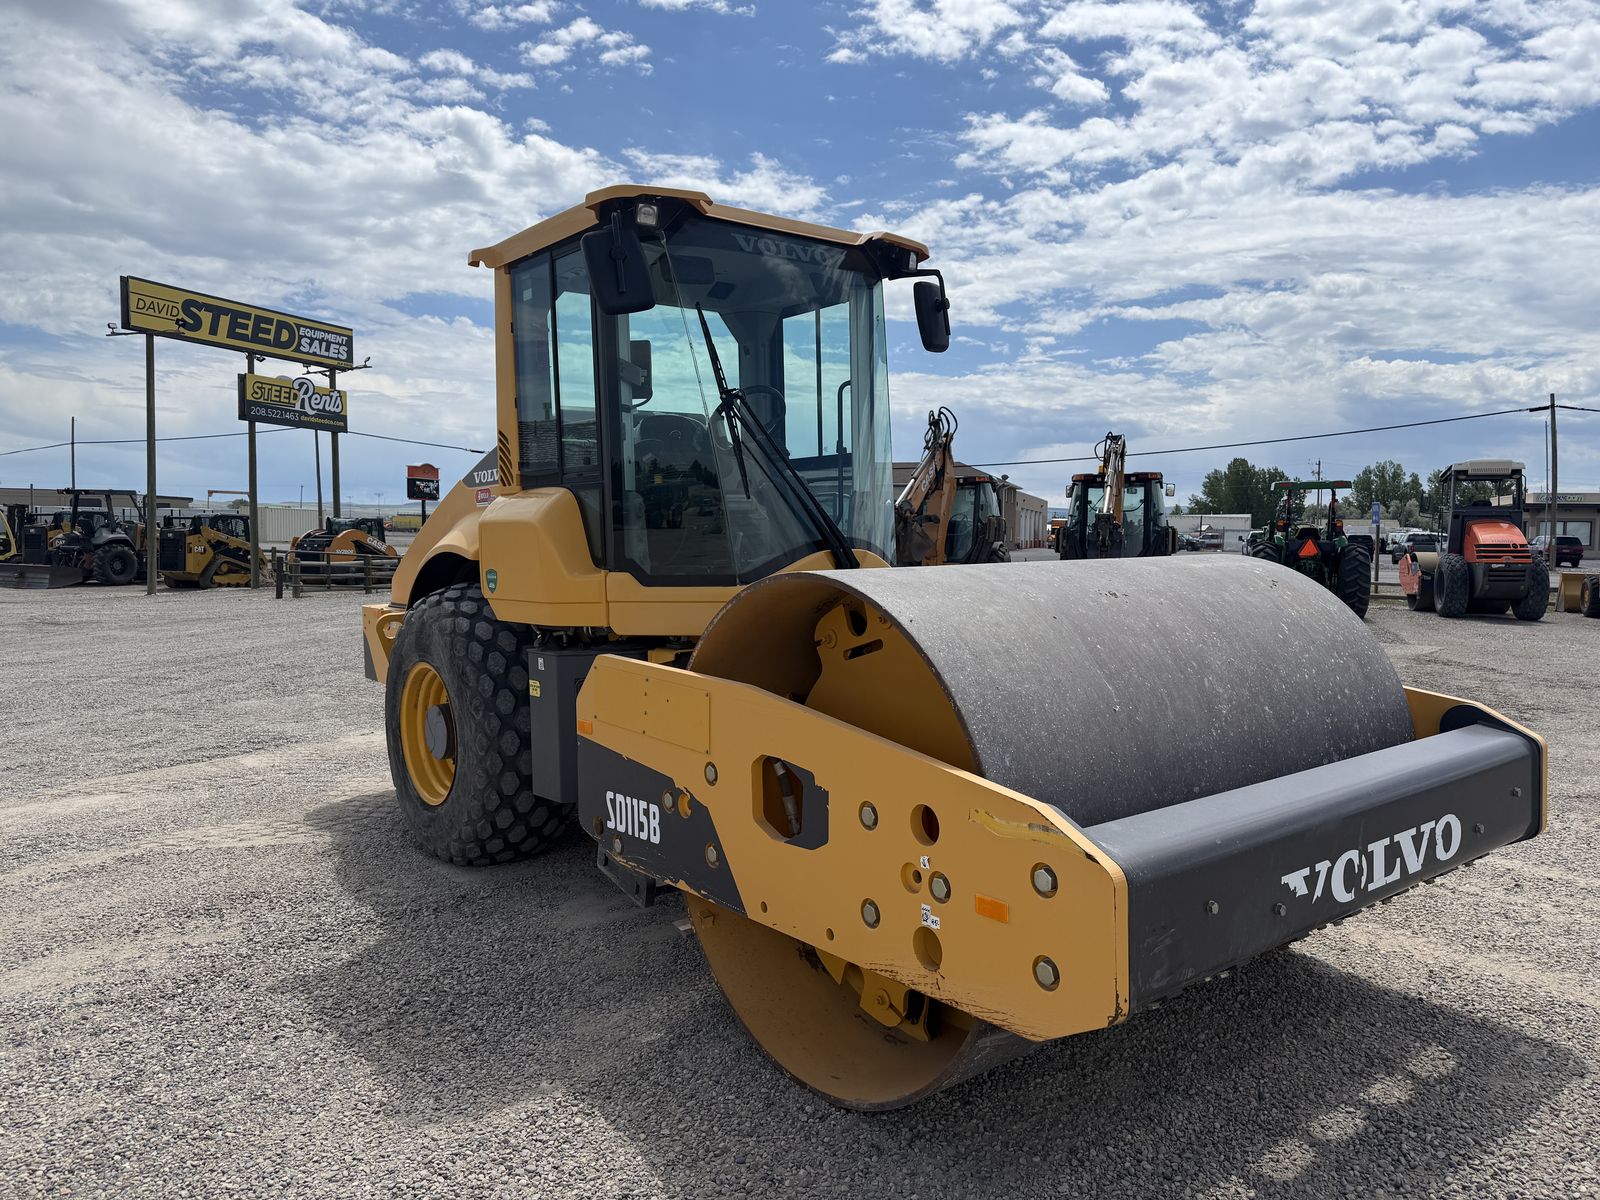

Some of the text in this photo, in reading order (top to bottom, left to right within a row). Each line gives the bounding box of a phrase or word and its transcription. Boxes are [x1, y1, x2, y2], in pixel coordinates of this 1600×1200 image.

[730, 232, 831, 266] VOLVO
[135, 298, 296, 350] DAVID STEED
[299, 327, 348, 345] EQUIPMENT
[300, 337, 348, 360] SALES
[252, 377, 343, 416] STEED Rents
[250, 406, 299, 421] 208.522.1463
[300, 415, 345, 427] davidsteedco.com
[194, 545, 205, 553] CAT
[367, 535, 388, 553] CASE
[606, 790, 661, 845] SD115B
[1281, 813, 1462, 904] VOLVO
